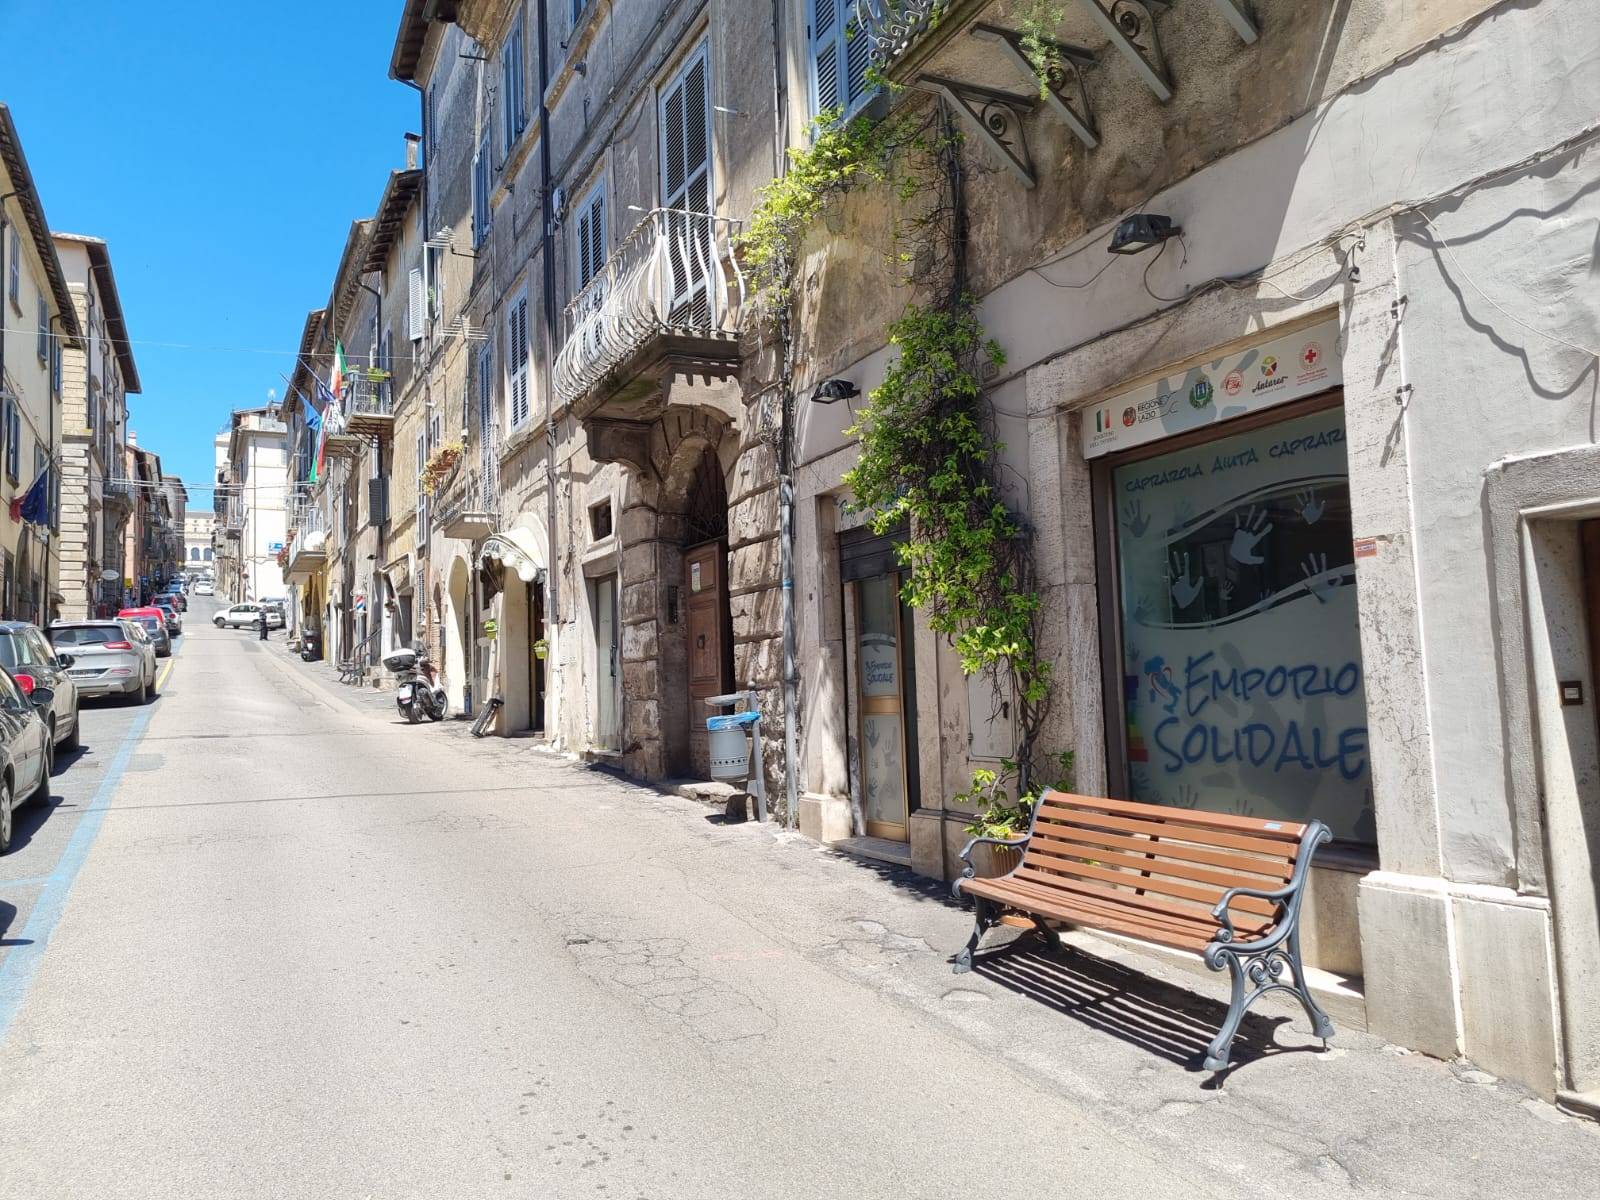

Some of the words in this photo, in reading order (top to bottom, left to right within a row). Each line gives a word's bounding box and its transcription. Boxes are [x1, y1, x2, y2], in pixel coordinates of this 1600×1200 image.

[1138, 410, 1156, 422] LAZIO
[1126, 463, 1203, 491] CAPRAROLA
[1211, 447, 1259, 473] AIUTA
[1269, 428, 1346, 459] CAPRAR
[1185, 651, 1358, 717] EMPORIO
[1154, 716, 1369, 780] SOLIDALE
